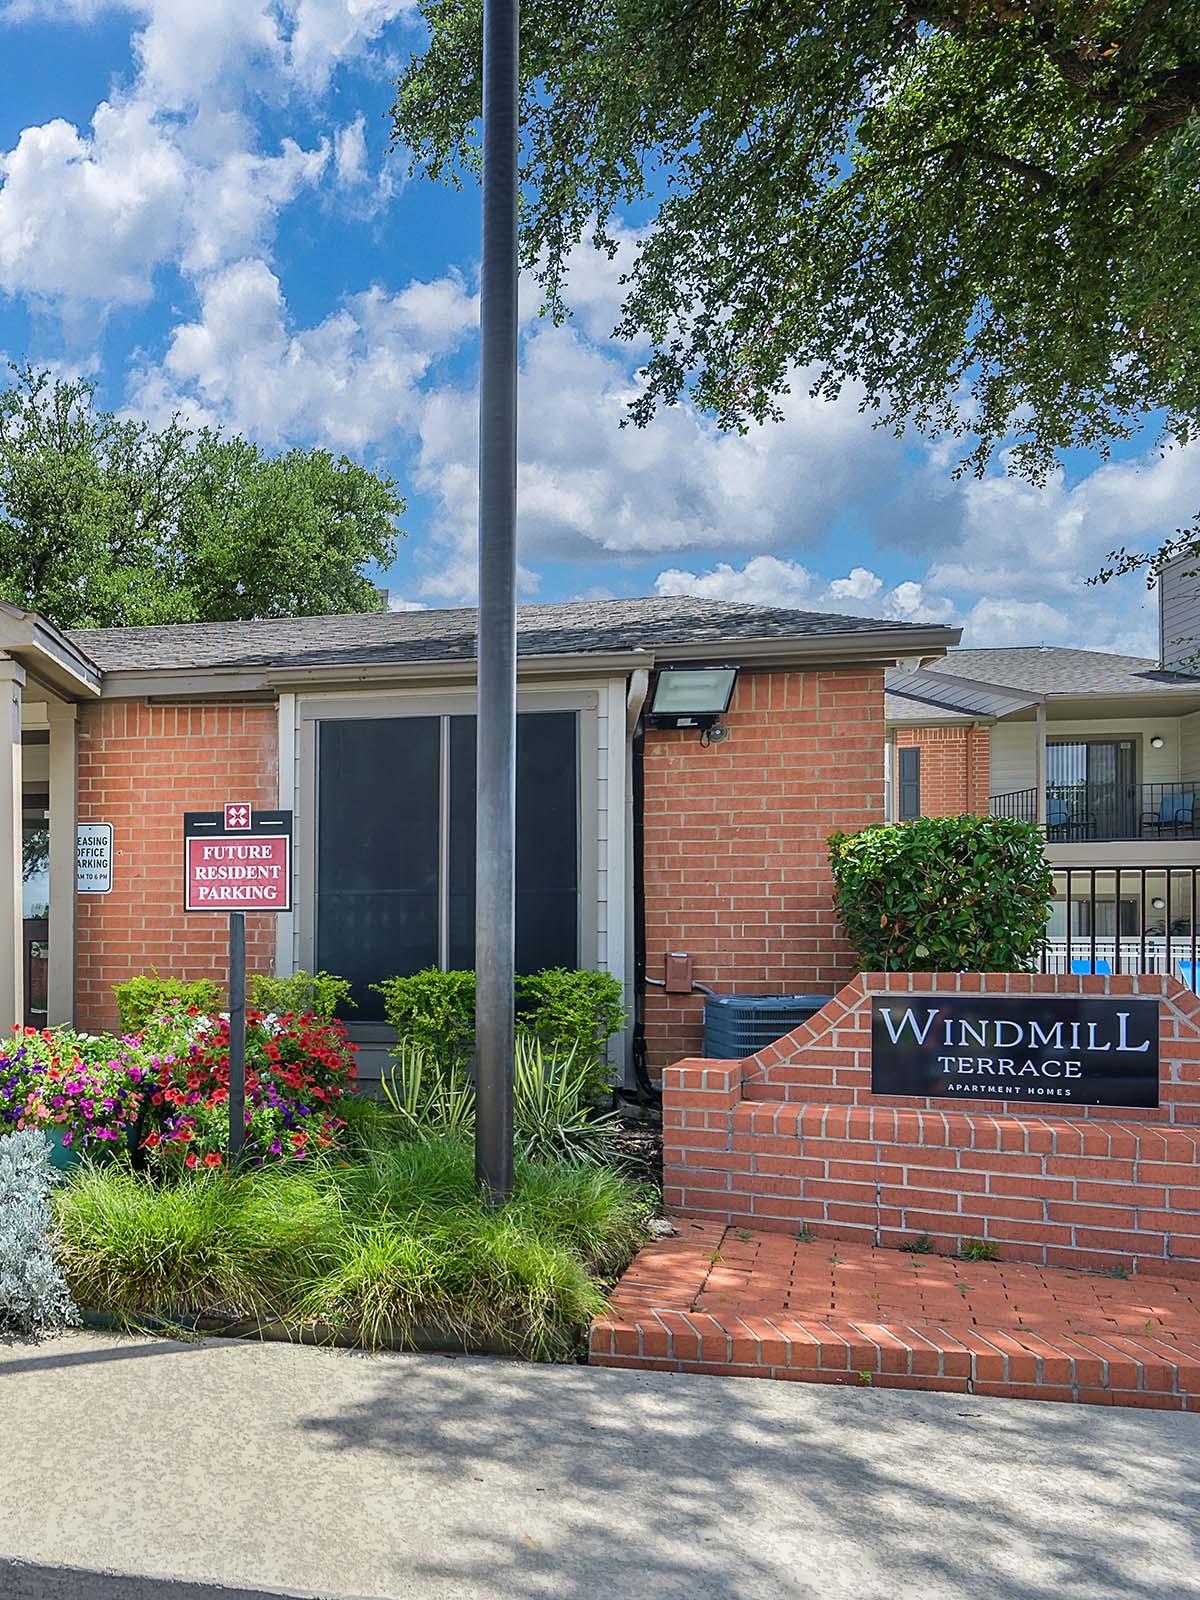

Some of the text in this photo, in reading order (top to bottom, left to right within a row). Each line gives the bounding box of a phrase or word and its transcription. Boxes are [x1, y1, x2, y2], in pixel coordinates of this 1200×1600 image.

[77, 836, 108, 846] EASING
[202, 845, 273, 860] FUTURE
[77, 859, 108, 868] ARKING
[194, 865, 282, 880] RESIDENT
[198, 885, 278, 900] PARKING
[878, 1007, 1150, 1053] WINDMILL
[937, 1056, 1083, 1079] TERRACE
[947, 1083, 1072, 1097] APARTMENT HOMES
